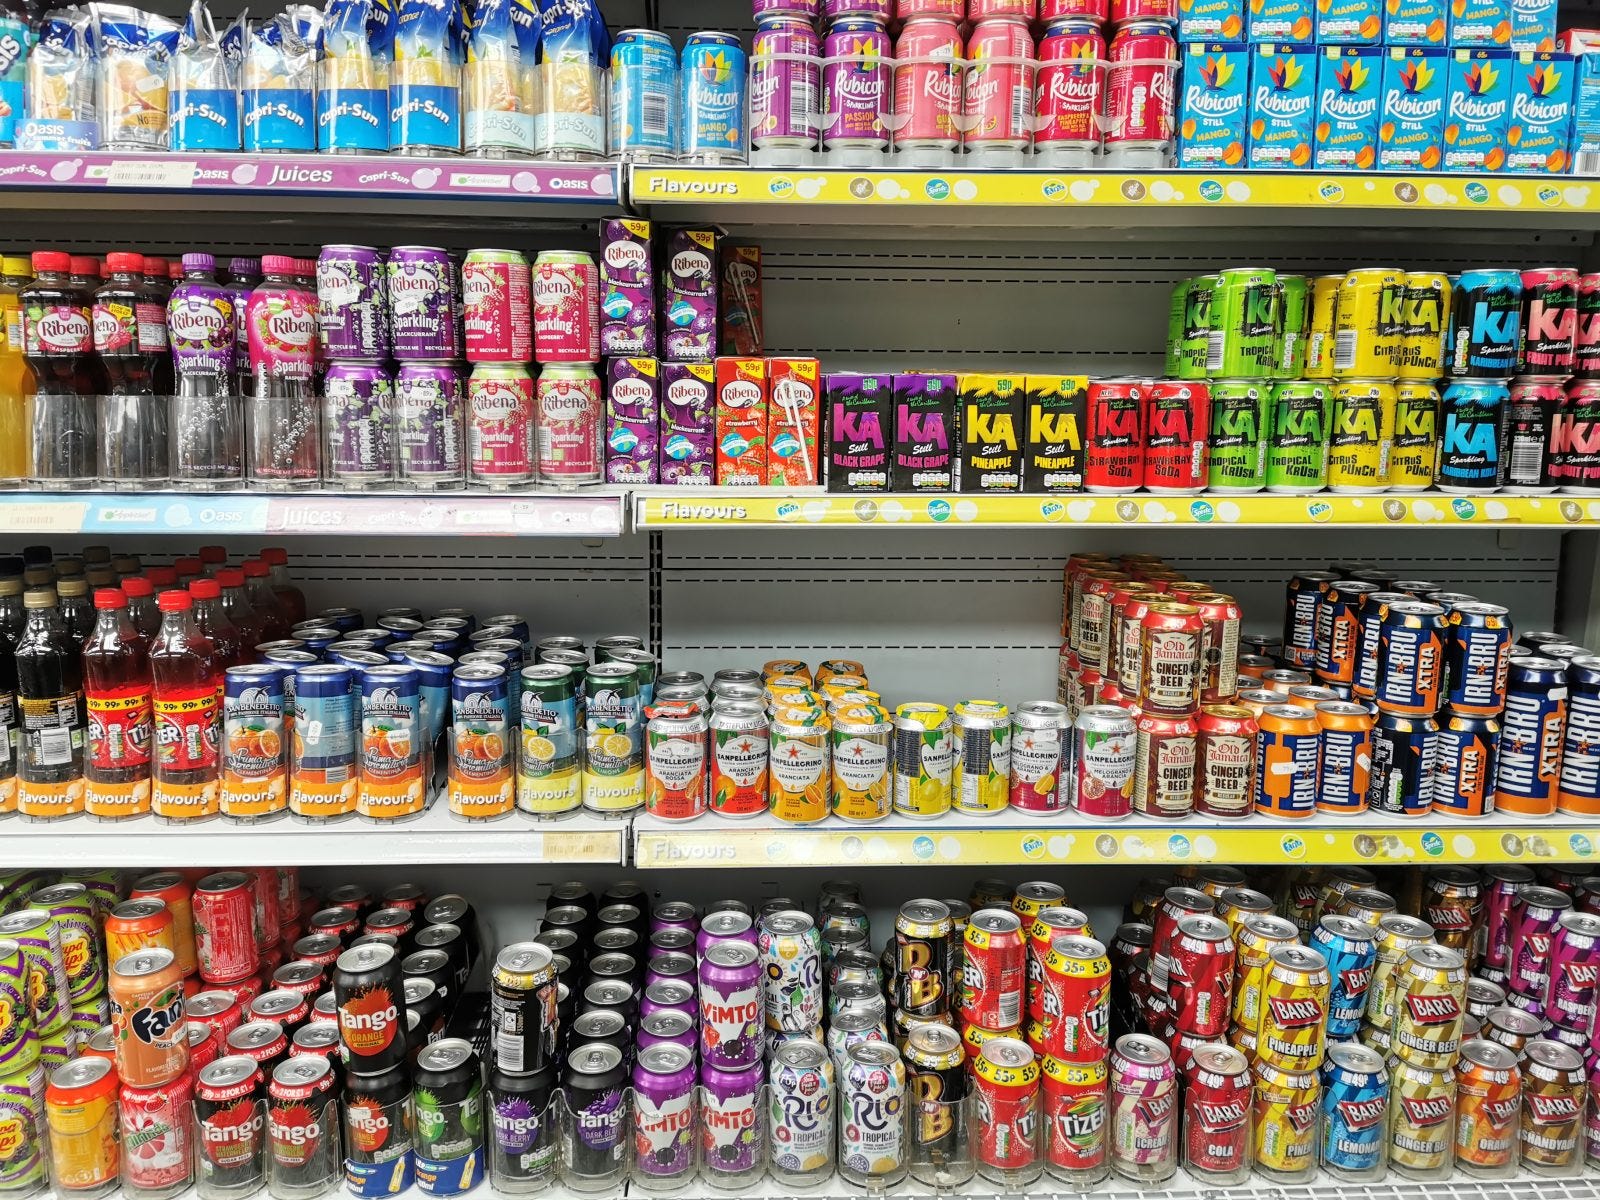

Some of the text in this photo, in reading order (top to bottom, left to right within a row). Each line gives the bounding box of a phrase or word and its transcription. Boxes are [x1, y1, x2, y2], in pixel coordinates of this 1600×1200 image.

[835, 69, 885, 98] Rubicon
[1255, 86, 1310, 116] Rubicon
[1321, 89, 1376, 119] Rubicon
[1385, 89, 1441, 119] Rubicon
[1450, 91, 1505, 121] Rubicon
[1513, 93, 1567, 122] Rubicon
[169, 103, 228, 129] Capri-Sun
[245, 103, 305, 129] Capri-Sun
[319, 101, 379, 128] Capri-Sun
[391, 98, 450, 125] Capri-Sun
[25, 122, 65, 136] Oasis
[1271, 119, 1292, 127] STILL
[1337, 122, 1358, 130] STILL
[1466, 124, 1486, 132] STILL
[1528, 125, 1549, 134] STILL
[1197, 129, 1230, 142] MANGO
[1265, 130, 1298, 142] MANGO
[1331, 133, 1364, 144] MANGO
[1459, 134, 1493, 147] MANGO
[1522, 136, 1555, 148] MANGO
[267, 166, 333, 186] Juices
[358, 171, 410, 185] Capri-Sun
[550, 177, 588, 190] Oasis
[650, 176, 738, 194] Flavours
[608, 247, 645, 263] Ribena
[674, 257, 709, 271] Ribena
[392, 275, 439, 293] Ribena
[173, 312, 223, 329] Ribena
[394, 314, 439, 333] Sparkling
[41, 319, 90, 338] Ribena
[179, 355, 221, 373] Sparkling
[695, 366, 711, 376] 59p
[745, 363, 761, 373] 59p
[797, 363, 813, 373] 59p
[671, 385, 707, 399] Ribena
[997, 379, 1012, 392] 59p
[1061, 379, 1076, 392] 59p
[725, 386, 760, 400] Ribena
[897, 405, 948, 450] KA
[967, 405, 1018, 450] KA
[1030, 405, 1081, 450] KA
[1213, 402, 1256, 442] KA
[1276, 402, 1320, 442] KA
[1334, 402, 1377, 441] KA
[480, 431, 514, 446] Sparkling
[551, 431, 585, 446] Sparkling
[1281, 437, 1308, 446] Sparkling
[1444, 413, 1497, 462] KA
[848, 443, 868, 454] Still
[912, 444, 933, 455] Still
[981, 445, 1001, 455] Still
[1045, 445, 1065, 455] Still
[834, 454, 885, 468] BLACK GRAPE
[898, 454, 949, 468] BLACK GRAPE
[971, 456, 1012, 469] PINEAPPLE
[1034, 456, 1075, 469] PINEAPPLE
[1208, 455, 1247, 467] TROPICAL
[1271, 455, 1311, 467] TROPICAL
[1329, 455, 1357, 466] CITRUS
[1392, 455, 1422, 466] CITRUS
[1450, 455, 1485, 464] Sparkling
[1221, 465, 1254, 479] KRUSH
[1286, 465, 1319, 479] KRUSH
[1341, 464, 1376, 477] PUNCH
[200, 510, 242, 523] Oasis
[279, 507, 342, 528] Juices
[551, 510, 588, 522] Oasis
[662, 502, 746, 519] Flavours
[1334, 620, 1350, 661] XTRA
[1156, 663, 1188, 676] GINGER
[1418, 646, 1435, 690] XTRA
[1160, 675, 1183, 688] BEER
[1541, 717, 1562, 775] XTRA
[717, 752, 769, 762] SANPELLEGRINO
[1163, 767, 1192, 780] GINGER
[1210, 765, 1243, 779] GINGER
[1461, 750, 1479, 793] XTRA
[1168, 779, 1188, 791] BEER
[1215, 778, 1239, 791] BEER
[19, 790, 73, 805] Flavours
[86, 790, 139, 805] Flavours
[293, 790, 347, 804] Flavours
[361, 793, 414, 807] Flavours
[453, 791, 506, 805] Flavours
[1279, 1000, 1319, 1020] BARR
[1411, 997, 1455, 1018] BARR
[338, 1005, 398, 1030] Tango
[351, 1030, 385, 1042] ORANGE
[1400, 1031, 1436, 1053] GINGER
[1268, 1037, 1318, 1057] PINEAPPLE
[1203, 1103, 1243, 1125] BARR
[1348, 1099, 1386, 1121] BARR
[1411, 1098, 1449, 1119] BARR
[1535, 1099, 1576, 1118] BARR
[202, 1114, 264, 1142] Tango
[792, 1132, 827, 1141] TROPICAL
[861, 1132, 896, 1141] TROPICAL
[1395, 1135, 1432, 1152] GINGER
[1208, 1144, 1234, 1157] COLA
